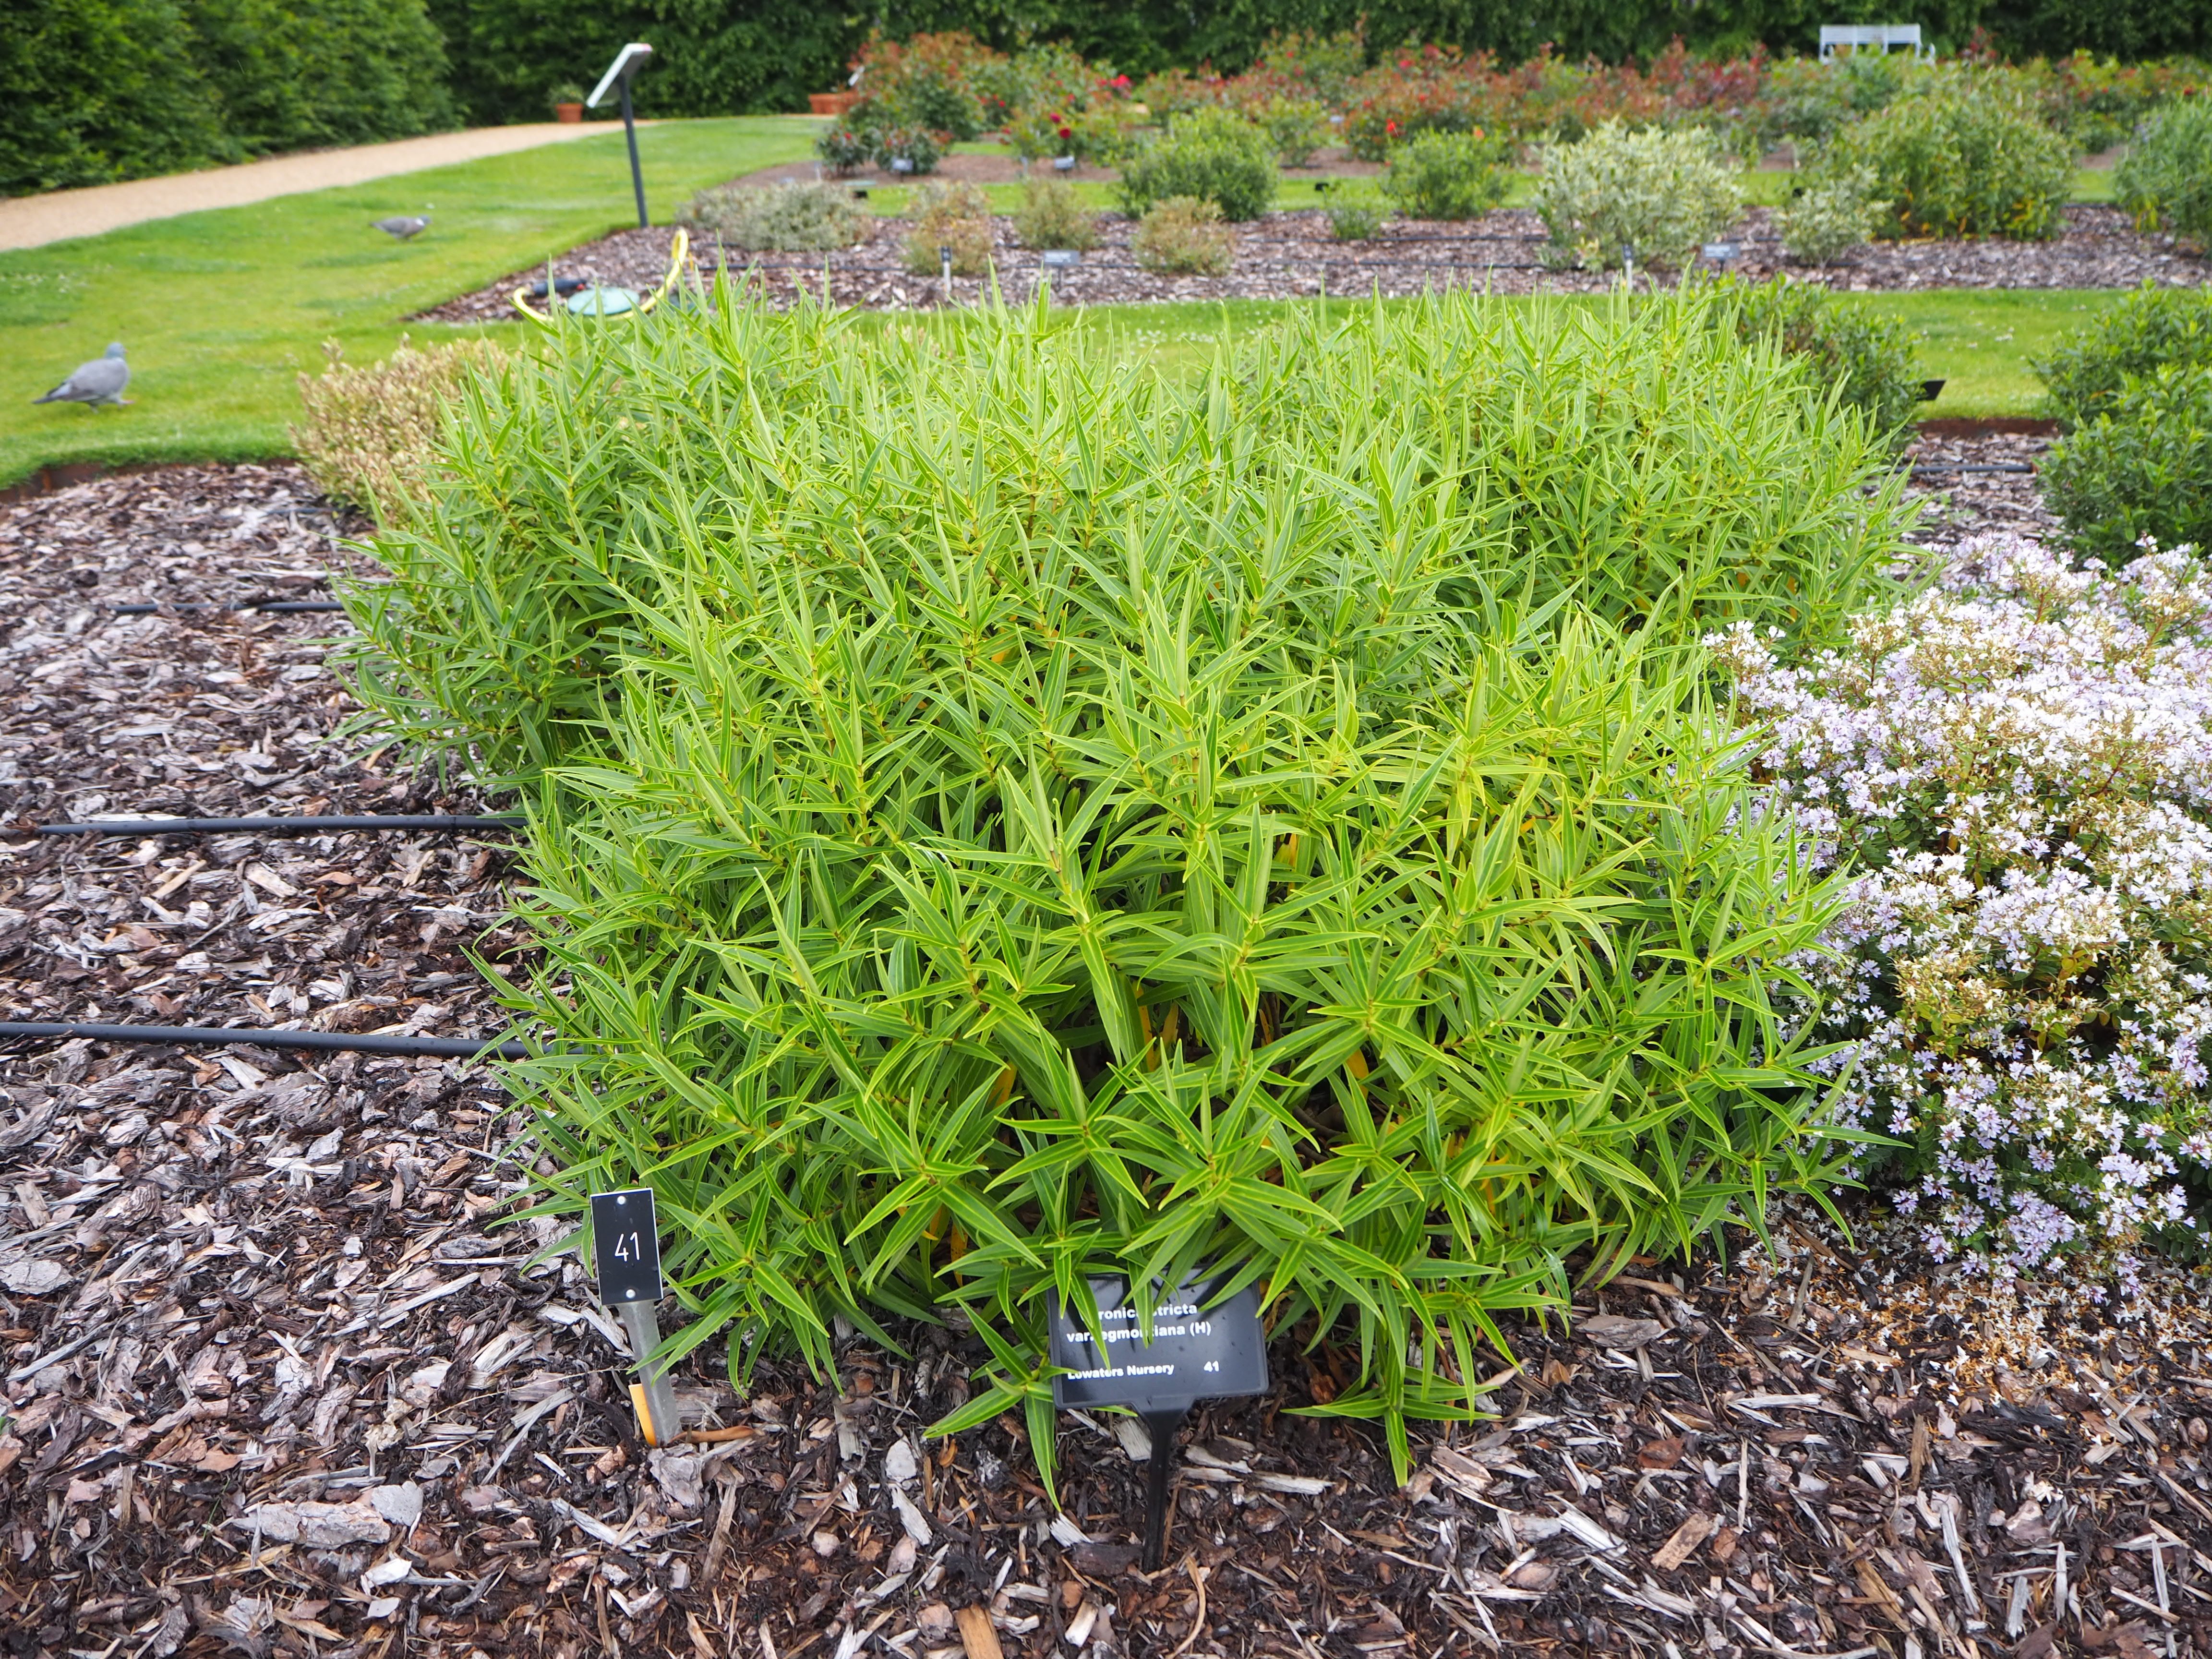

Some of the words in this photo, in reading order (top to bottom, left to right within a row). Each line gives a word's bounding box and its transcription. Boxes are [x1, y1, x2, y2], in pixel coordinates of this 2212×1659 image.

[614, 1232, 640, 1262] 41
[1079, 1306, 1139, 1321] ronic
[1067, 1331, 1094, 1343] var.
[1190, 1321, 1211, 1336] (H)
[1127, 1364, 1174, 1376] Nursery
[1203, 1360, 1220, 1372] 41
